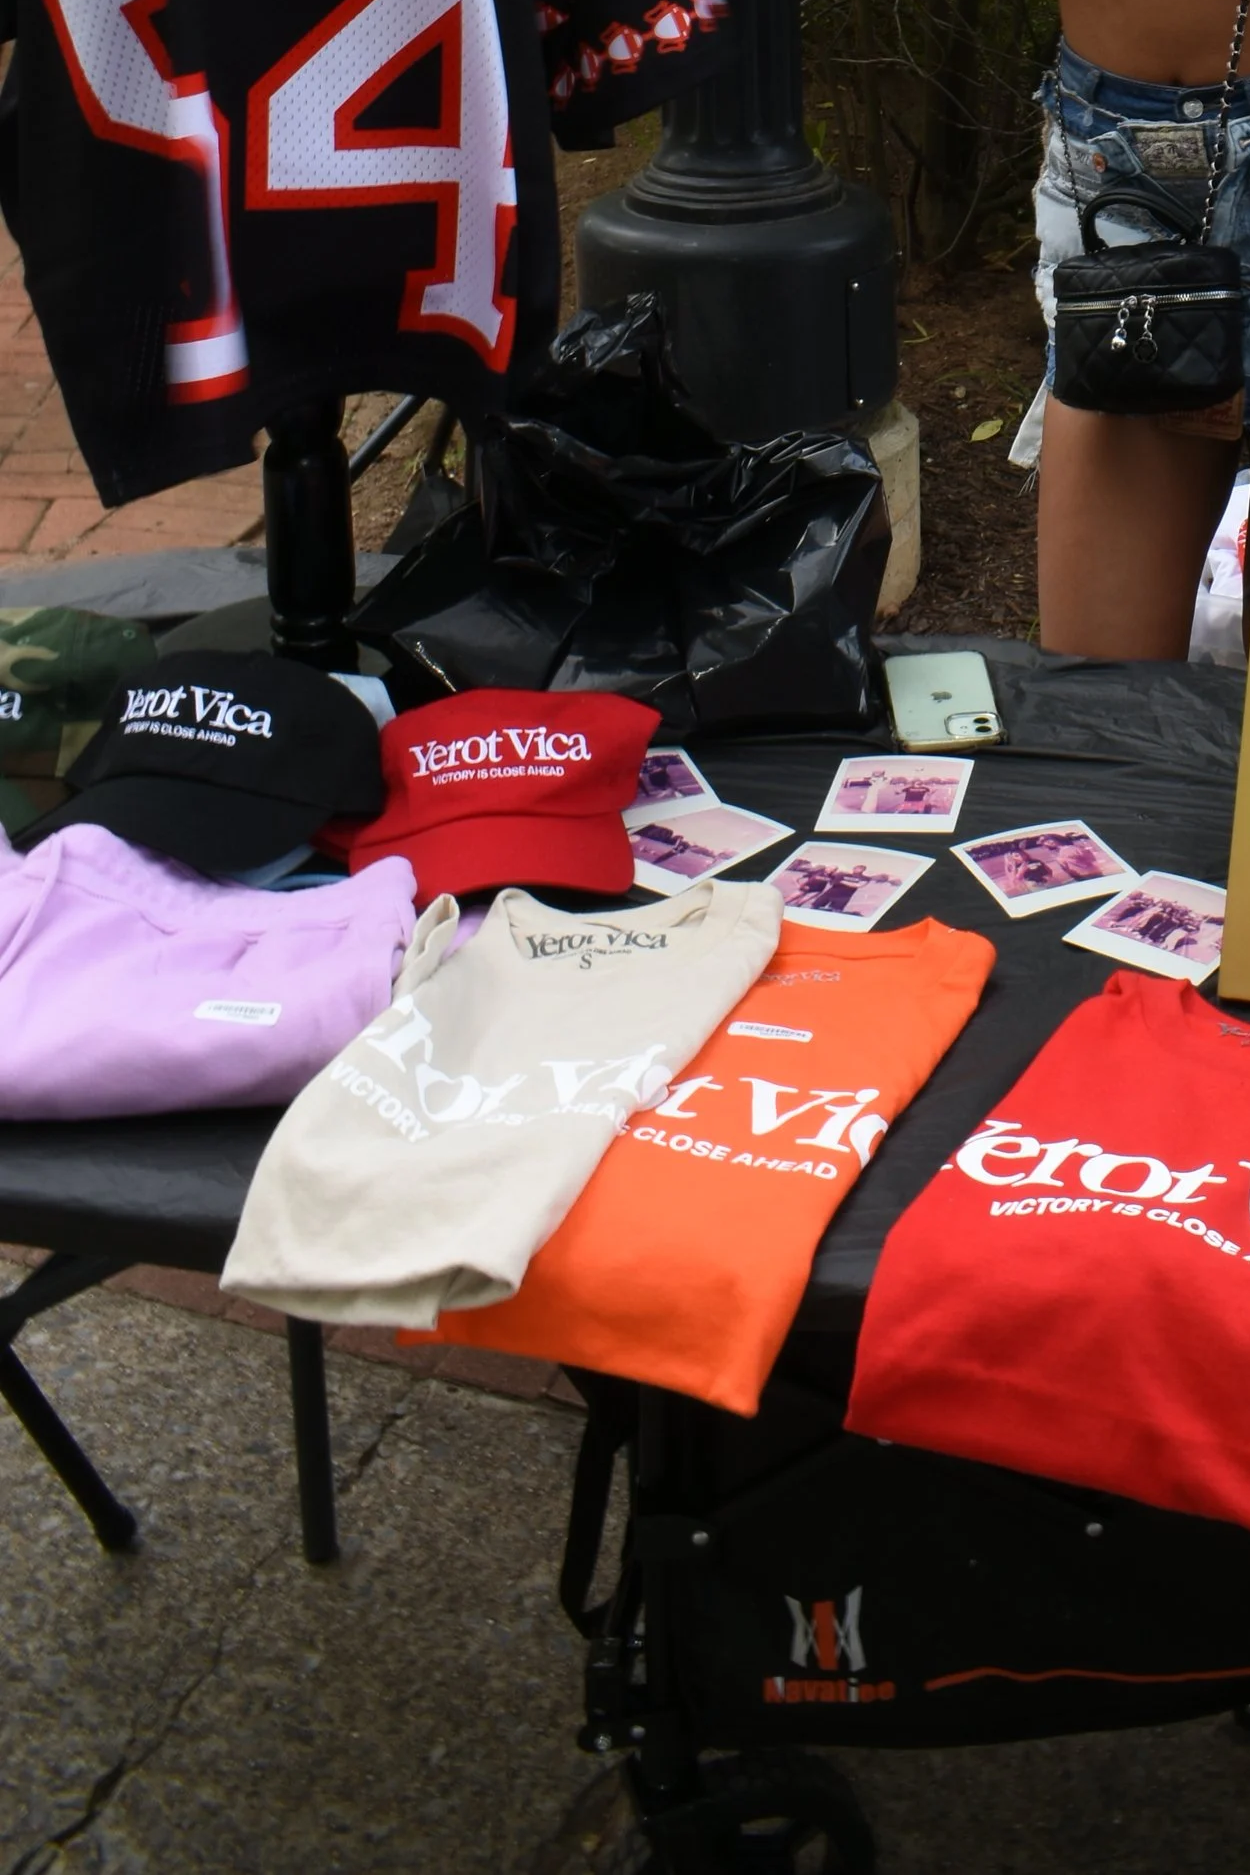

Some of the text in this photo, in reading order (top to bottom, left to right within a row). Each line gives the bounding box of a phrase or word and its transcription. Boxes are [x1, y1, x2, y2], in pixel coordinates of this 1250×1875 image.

[119, 685, 273, 739] Yerot Vica
[160, 723, 197, 740] CLOSE
[196, 729, 236, 747] AHEAD
[408, 726, 592, 778] Yerot Vica
[432, 765, 565, 786] VICTORY IS CLOSE AHEAD
[579, 953, 593, 970] S
[330, 1061, 429, 1142] VICTORY
[633, 1127, 839, 1180] CLOSE AHEAD
[989, 1196, 1113, 1217] VICTORY
[1111, 1201, 1144, 1217] IS
[1146, 1207, 1241, 1257] CLOSE
